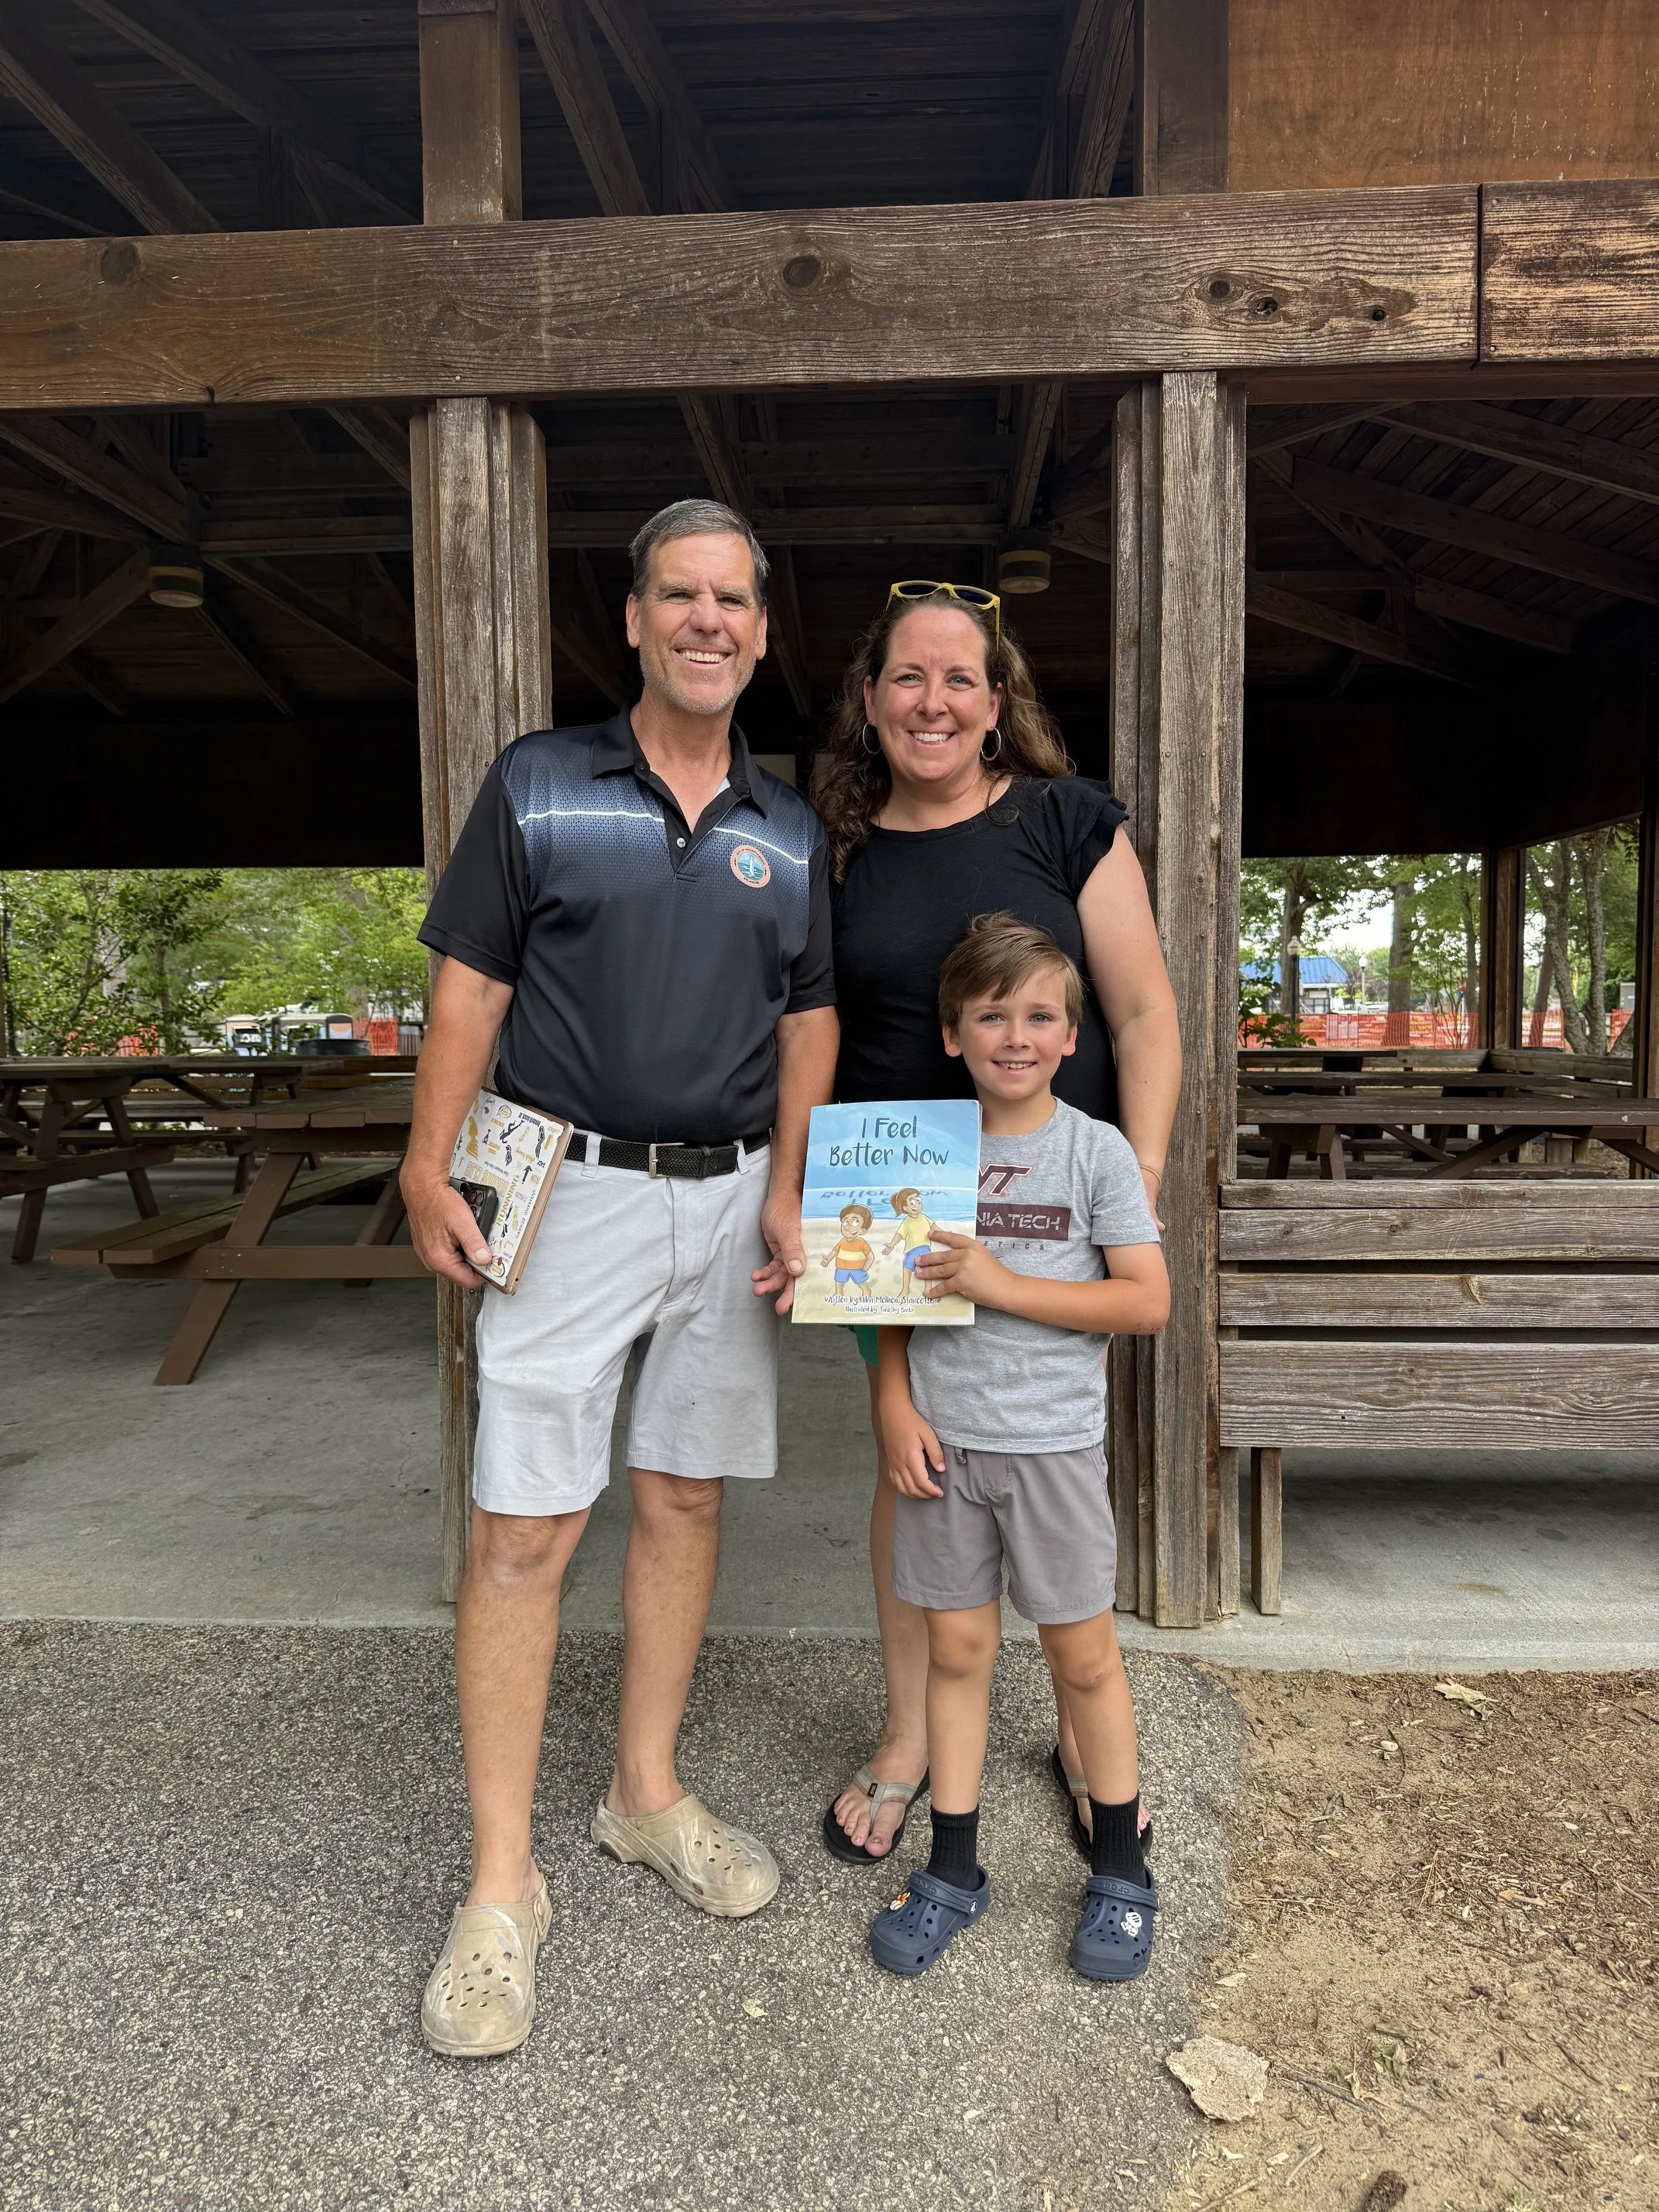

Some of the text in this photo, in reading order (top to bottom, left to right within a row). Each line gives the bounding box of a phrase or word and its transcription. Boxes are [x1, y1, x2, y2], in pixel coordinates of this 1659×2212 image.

[861, 1115, 917, 1139] I Feel
[830, 1142, 950, 1167] Better Now
[496, 1174, 520, 1227] RUNNING
[1008, 1213, 1062, 1231] TECH
[850, 1295, 857, 1306] by
[871, 1306, 878, 1314] by
